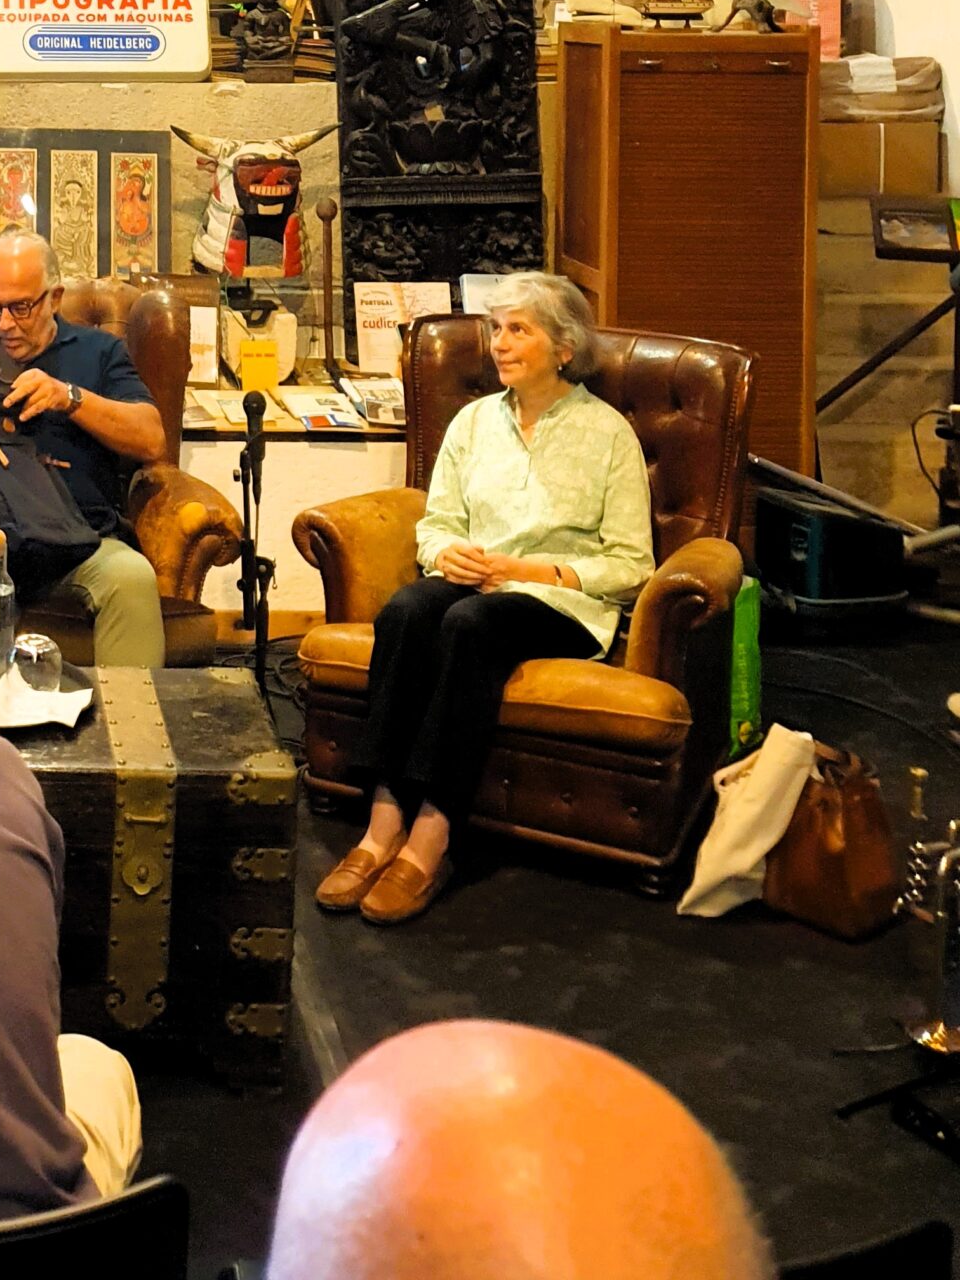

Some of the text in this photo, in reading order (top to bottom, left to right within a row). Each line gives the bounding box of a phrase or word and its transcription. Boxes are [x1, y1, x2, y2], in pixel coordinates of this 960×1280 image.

[76, 13, 107, 23] COM
[115, 11, 194, 24] MÁQUINAS
[37, 37, 152, 49] ORIGINAL HEIDELBERG
